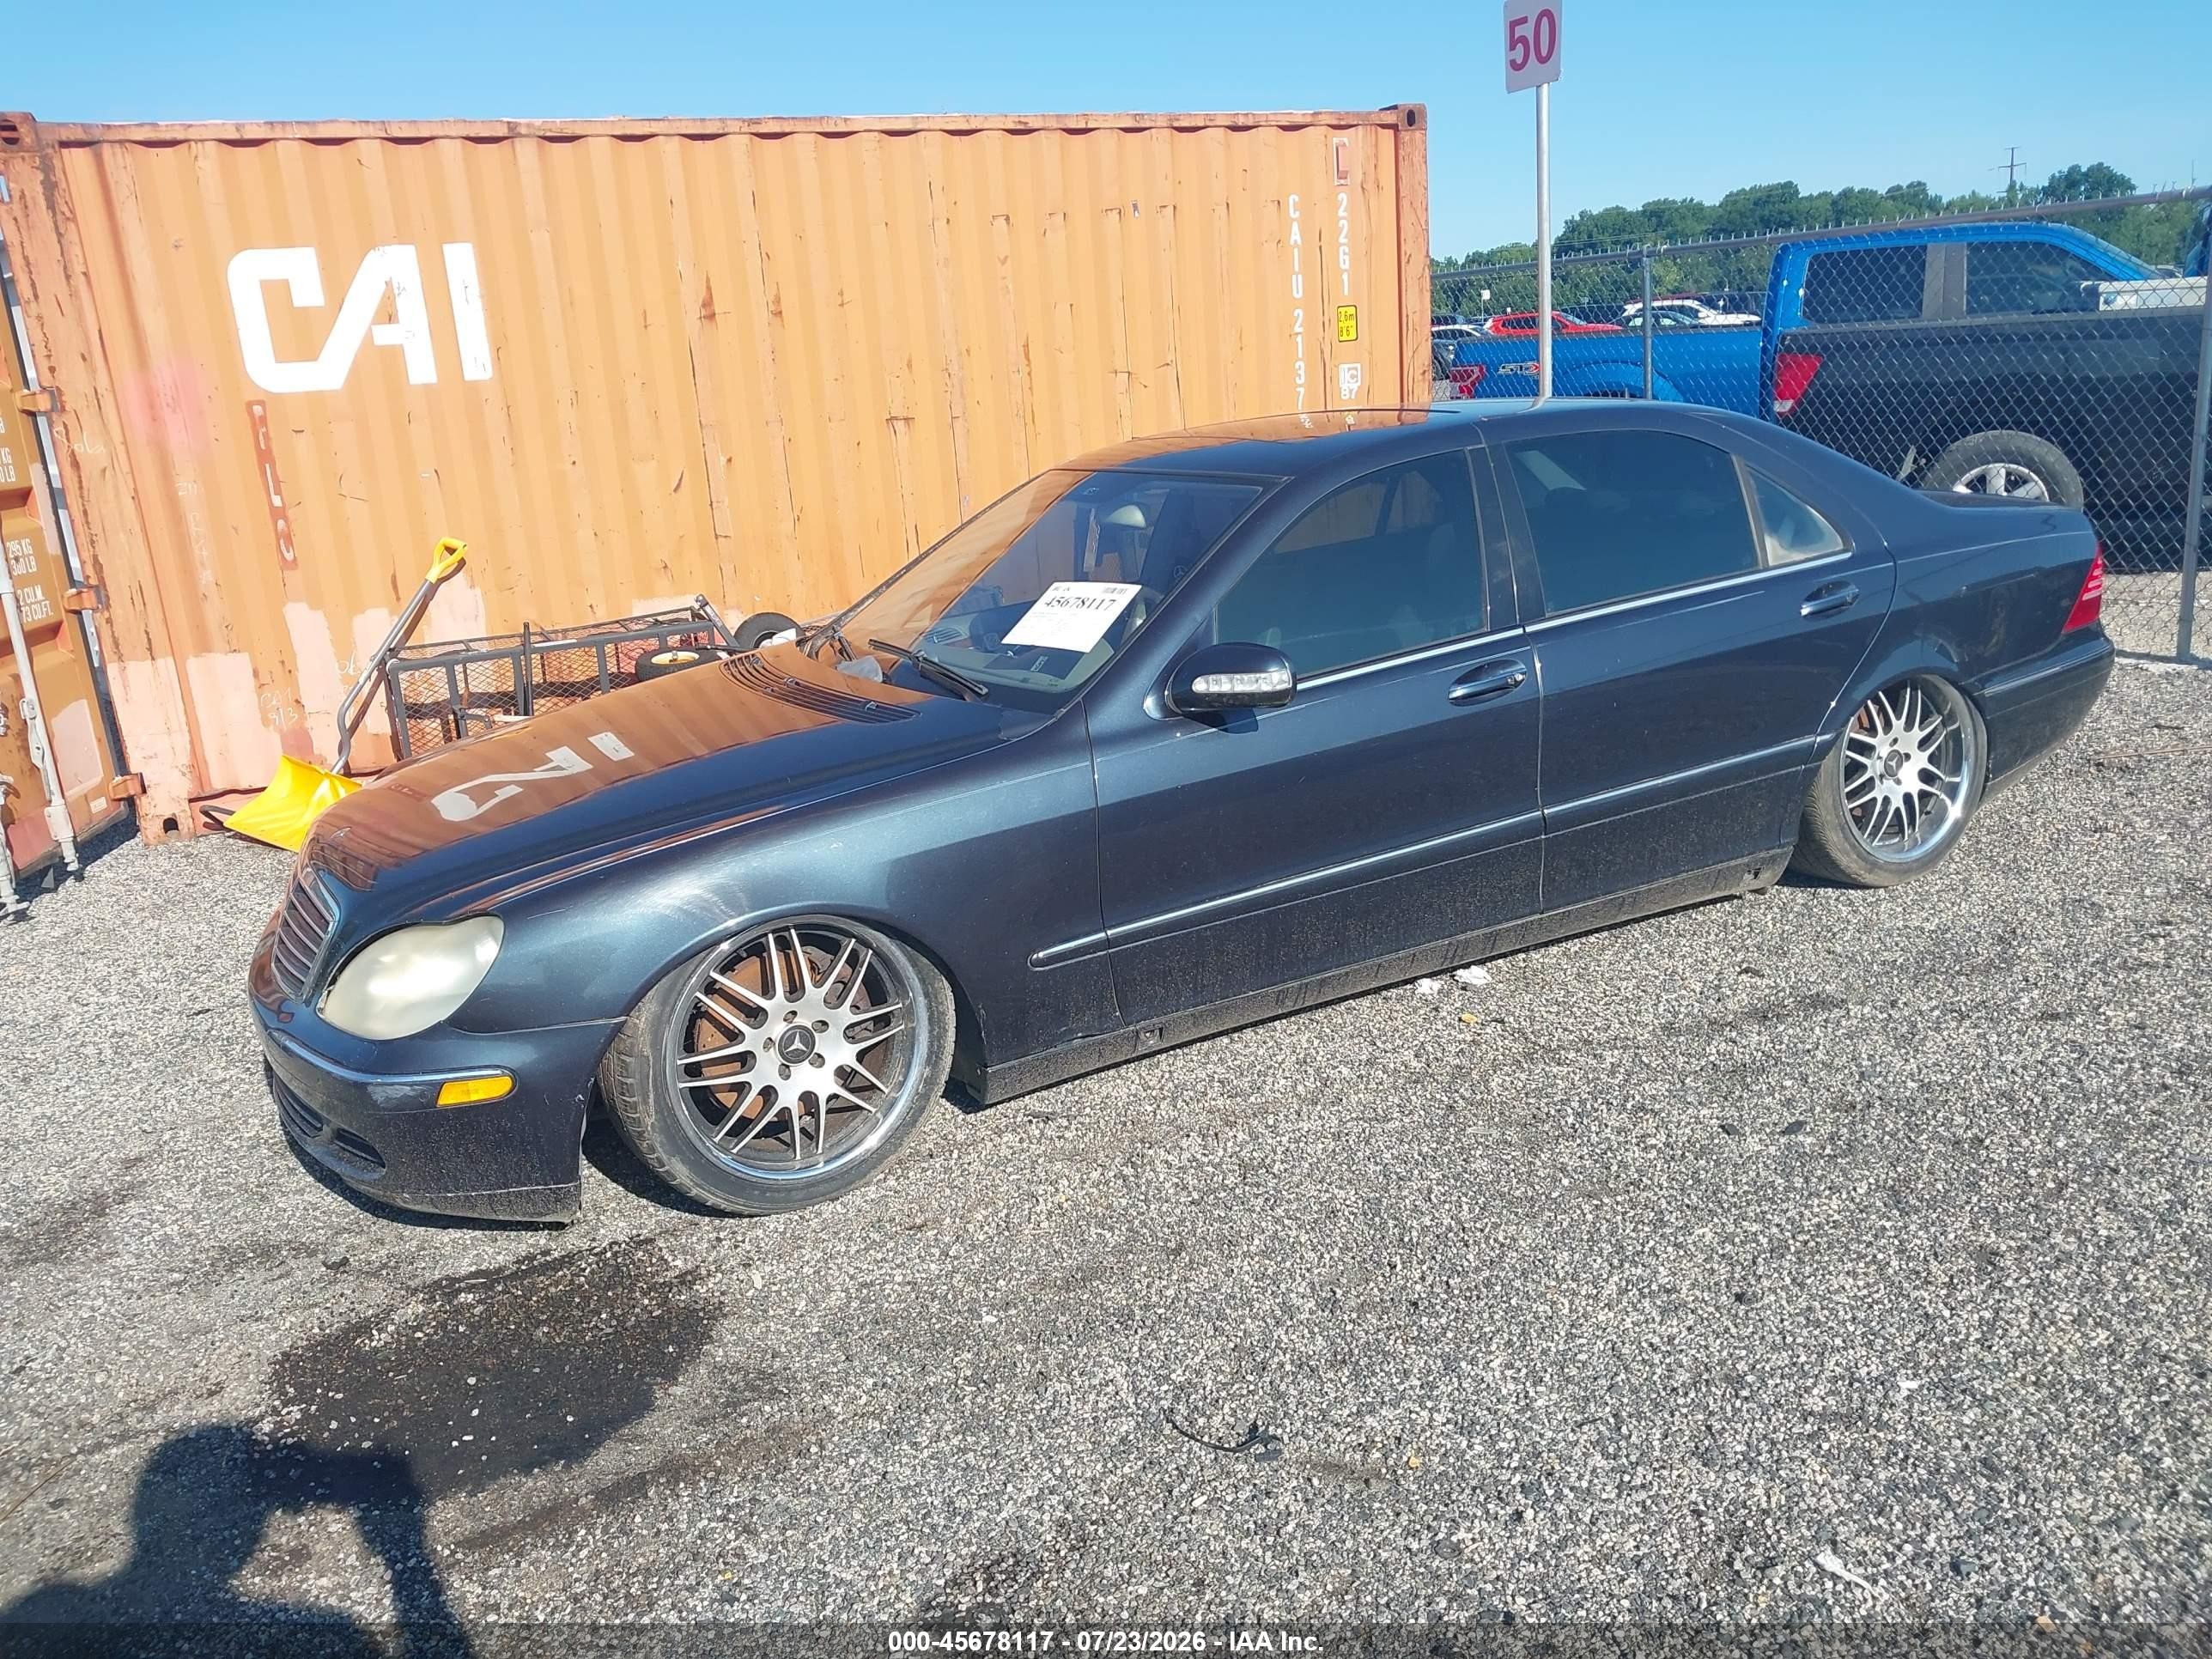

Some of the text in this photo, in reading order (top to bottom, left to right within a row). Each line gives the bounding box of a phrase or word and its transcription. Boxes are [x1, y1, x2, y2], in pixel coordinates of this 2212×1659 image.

[1509, 9, 1556, 71] 50
[1288, 193, 1304, 299] CAIU
[1337, 192, 1349, 295] 22G1
[227, 242, 492, 392] CAI
[21, 539, 33, 555] KG
[26, 556, 37, 573] LB
[1044, 596, 1118, 611] 45678117
